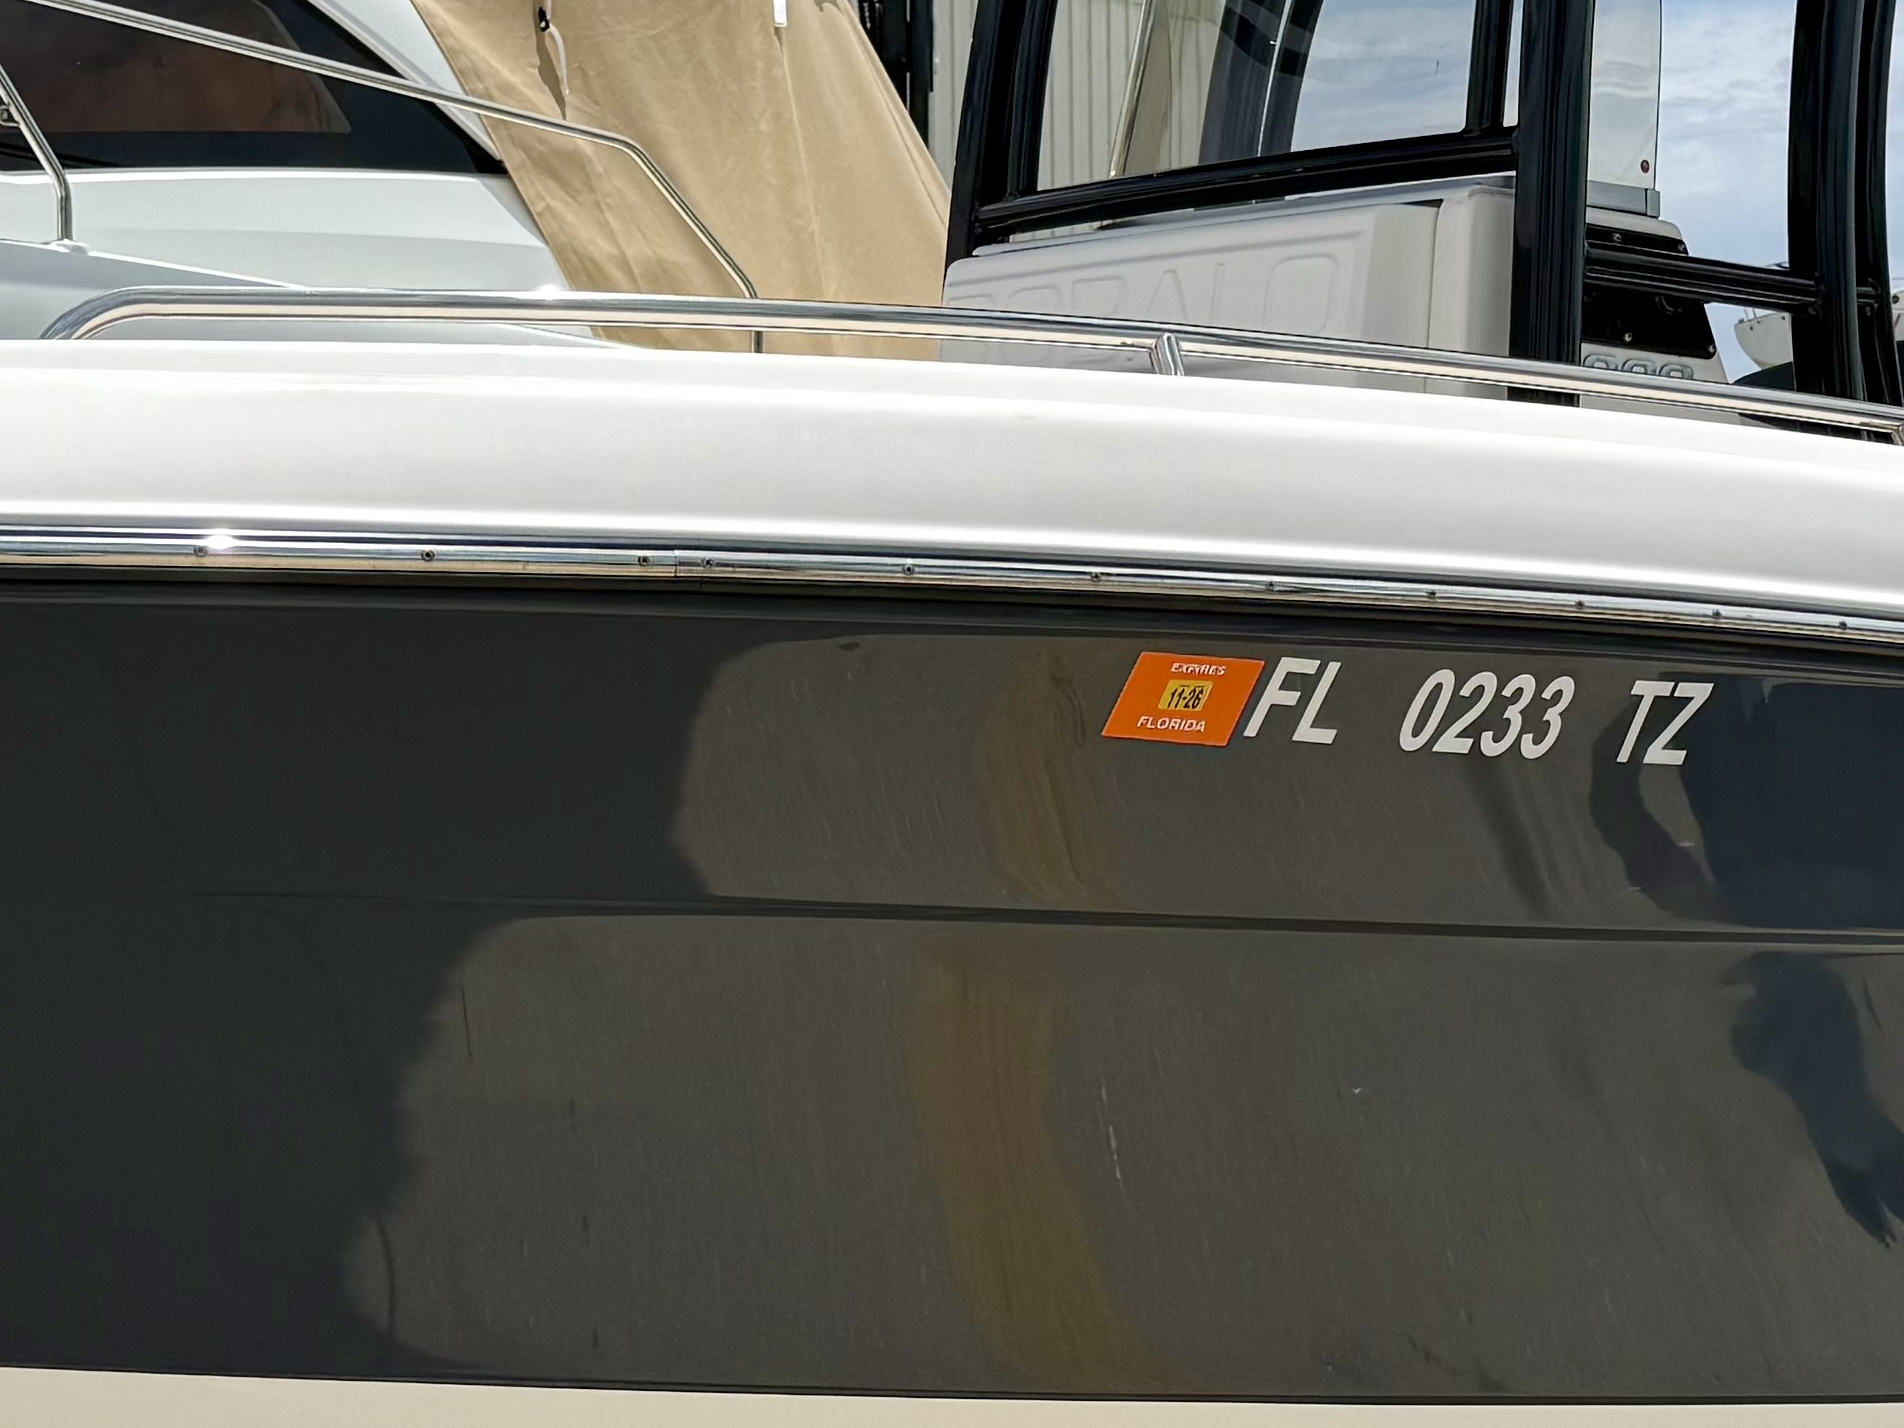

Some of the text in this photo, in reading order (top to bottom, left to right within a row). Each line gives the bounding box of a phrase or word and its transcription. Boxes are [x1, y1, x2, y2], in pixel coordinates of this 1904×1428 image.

[1136, 715, 1206, 732] FLORIDA
[1242, 656, 1715, 766] FL 0233 TZ
